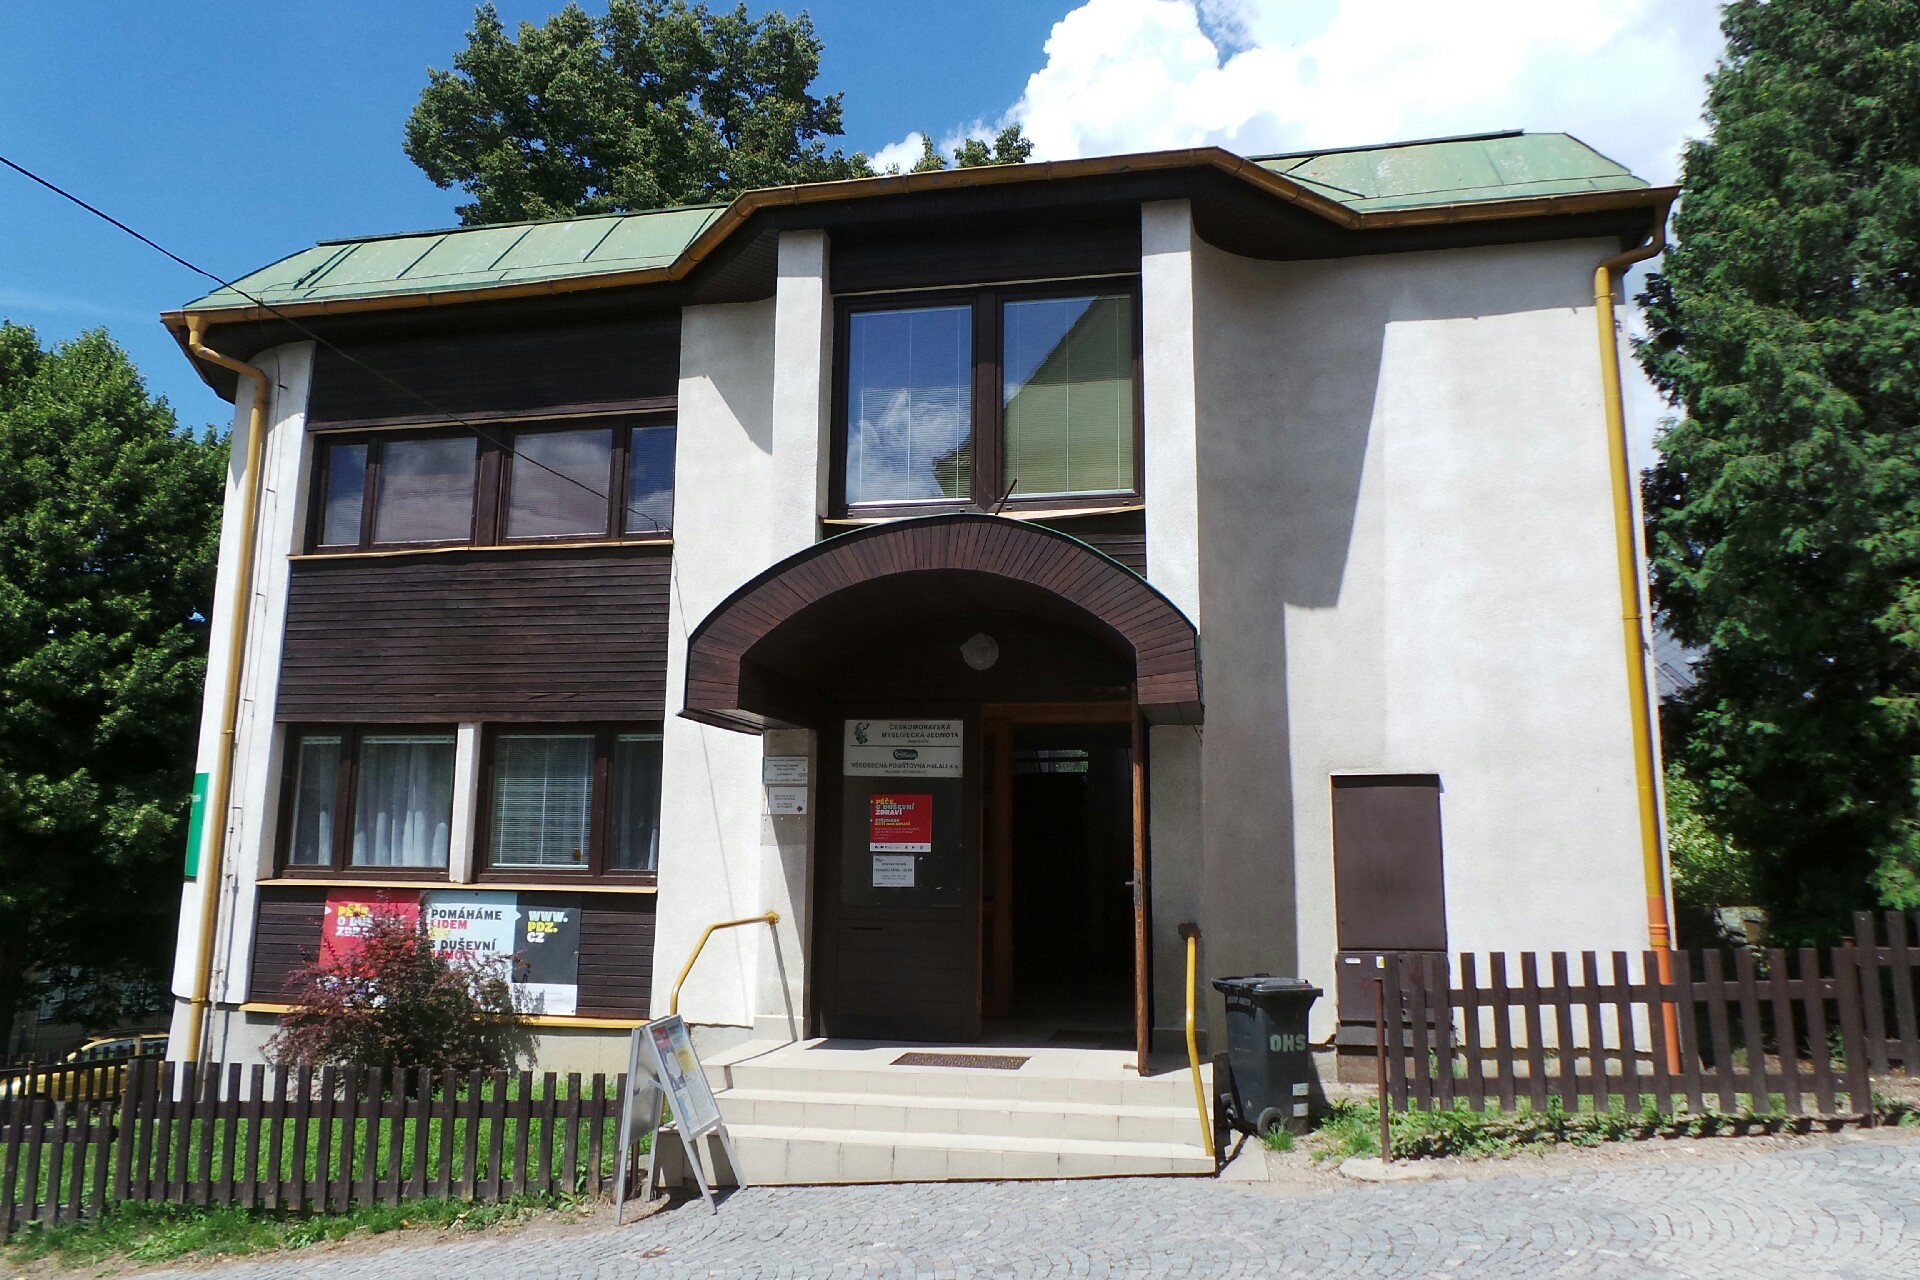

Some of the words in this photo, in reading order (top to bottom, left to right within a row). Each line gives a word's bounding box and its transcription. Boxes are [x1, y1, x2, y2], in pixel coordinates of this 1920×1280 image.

[875, 808, 902, 816] ZDRAVÍ
[430, 907, 503, 920] POMÁHÁME
[528, 910, 569, 923] WWW.
[337, 916, 346, 926] O
[527, 922, 558, 933] PDZ.
[526, 932, 545, 943] CZ
[440, 938, 497, 951] DUŠEVNÍ
[1269, 1033, 1307, 1052] OHS
